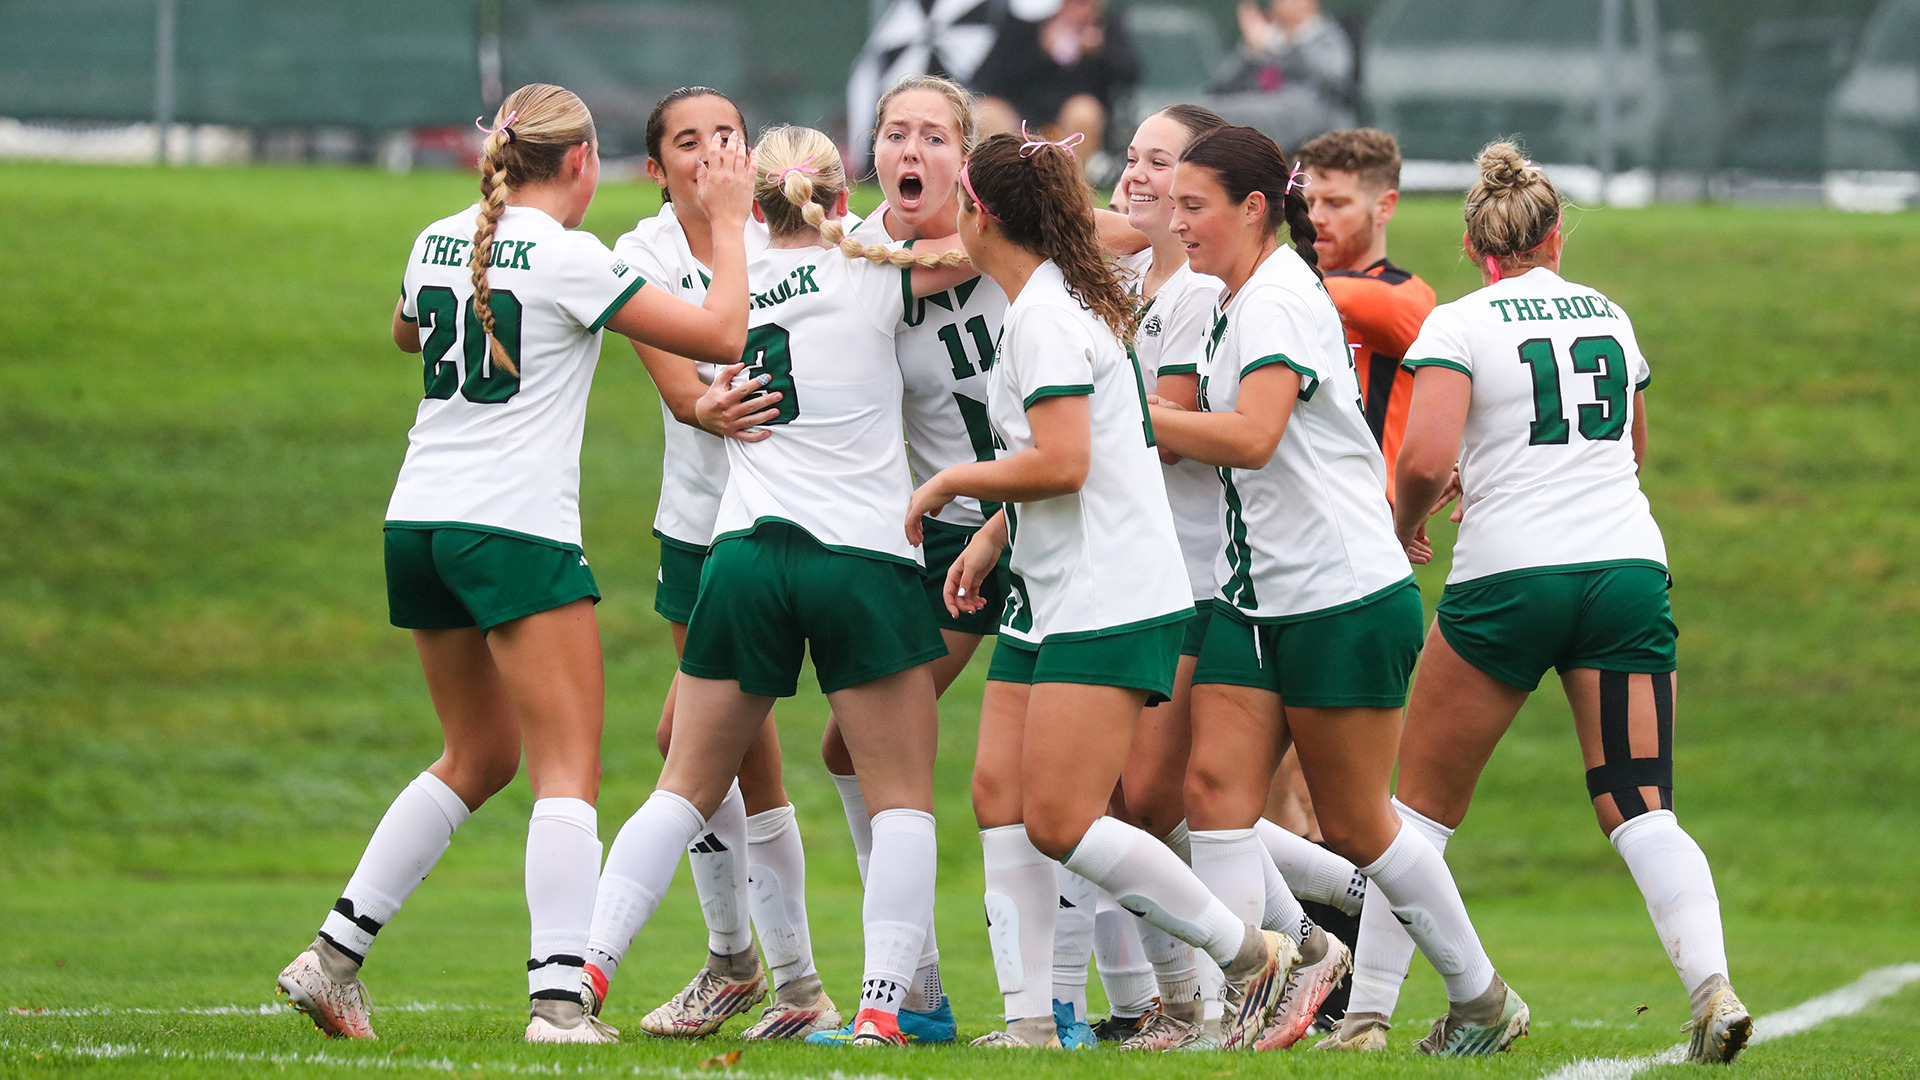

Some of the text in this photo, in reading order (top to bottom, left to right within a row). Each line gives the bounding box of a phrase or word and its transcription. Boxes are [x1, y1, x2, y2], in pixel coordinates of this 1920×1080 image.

[421, 235, 537, 270] THE OCK
[1489, 296, 1619, 322] THE ROCK
[416, 285, 523, 404] 20
[937, 314, 996, 382] 11
[1517, 335, 1628, 446] 13
